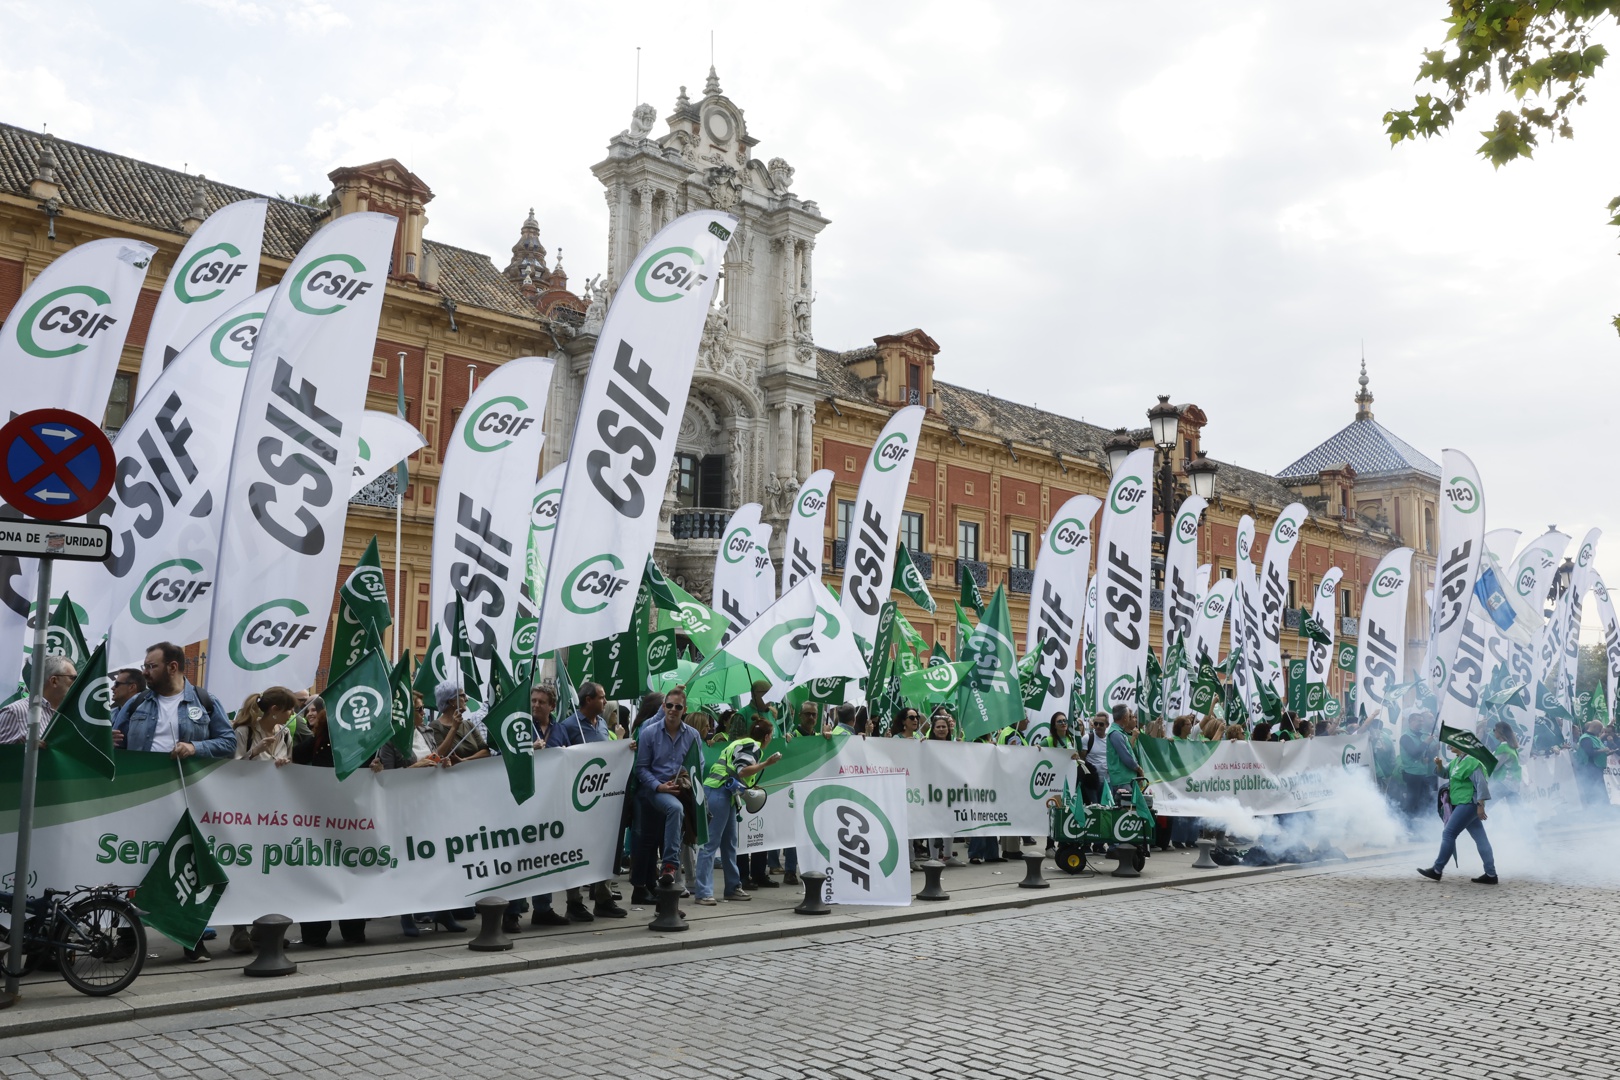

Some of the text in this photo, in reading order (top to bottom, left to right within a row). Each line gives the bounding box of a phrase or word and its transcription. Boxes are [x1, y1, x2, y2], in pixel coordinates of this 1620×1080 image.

[708, 224, 729, 240] JAÉN
[190, 260, 247, 286] CSIF
[651, 261, 708, 291] CSIF
[306, 270, 373, 301] CSIF
[39, 305, 118, 340] CSIF
[229, 325, 258, 351] CS
[478, 411, 534, 439] CSIF
[587, 339, 670, 519] CSIF
[249, 356, 343, 556] CSIF
[881, 443, 909, 462] CSIF
[87, 390, 199, 578] CSIF
[1117, 486, 1147, 504] CSIF
[535, 499, 560, 519] CS
[803, 495, 825, 512] CSIF
[0, 531, 103, 548] ONA DE URIDAD
[1057, 527, 1088, 547] CSIF
[1280, 524, 1297, 539] CSIF
[729, 536, 755, 555] CSIF
[849, 499, 889, 616] CSIF
[1541, 557, 1555, 569] IF
[444, 491, 513, 660] CSIF
[577, 571, 629, 598] CSIF
[1378, 575, 1405, 591] CSIF
[145, 577, 212, 603] CSIF
[360, 573, 389, 604] CSIF
[1104, 541, 1142, 651] CSIF
[1196, 601, 1204, 612] IF
[1263, 560, 1285, 644] CSIF
[682, 609, 711, 633] CSIF
[246, 619, 317, 649] CSIF
[519, 631, 537, 644] CS
[1037, 579, 1073, 698] CSIF
[346, 630, 365, 667] CS
[650, 643, 672, 659] CSIF
[1342, 653, 1355, 661] CSIF
[579, 641, 593, 688] SIF
[968, 636, 1010, 694] CSIF
[1364, 618, 1397, 706] CSIF
[1447, 619, 1485, 709] CSIF
[818, 677, 842, 689] CSIF
[1271, 670, 1281, 682] IF
[970, 680, 989, 722] Córdoba
[1110, 686, 1138, 704] CSIF
[1168, 697, 1181, 711] CS
[1196, 690, 1212, 702] CSIF
[1310, 691, 1322, 701] CSIF
[350, 695, 371, 732] CSIF
[1251, 701, 1263, 715] CS
[1326, 703, 1339, 711] CSIF
[512, 719, 533, 757] CSIF
[838, 765, 864, 774] AHORA
[1230, 761, 1241, 769] MÁS
[1345, 752, 1361, 765] CSIF
[579, 773, 610, 794] CSIF
[1034, 771, 1056, 787] CSIF
[1185, 777, 1230, 793] Servicios
[928, 783, 943, 802] lo
[947, 782, 997, 808] primero
[200, 811, 375, 830] AHORA MÁS QUE NUNCA
[954, 809, 968, 822] Tú
[977, 810, 1008, 822] mereces
[96, 820, 564, 874] Serios públicos, lo primero
[837, 805, 870, 892] CSIF
[462, 848, 583, 880] Tú lo mereces
